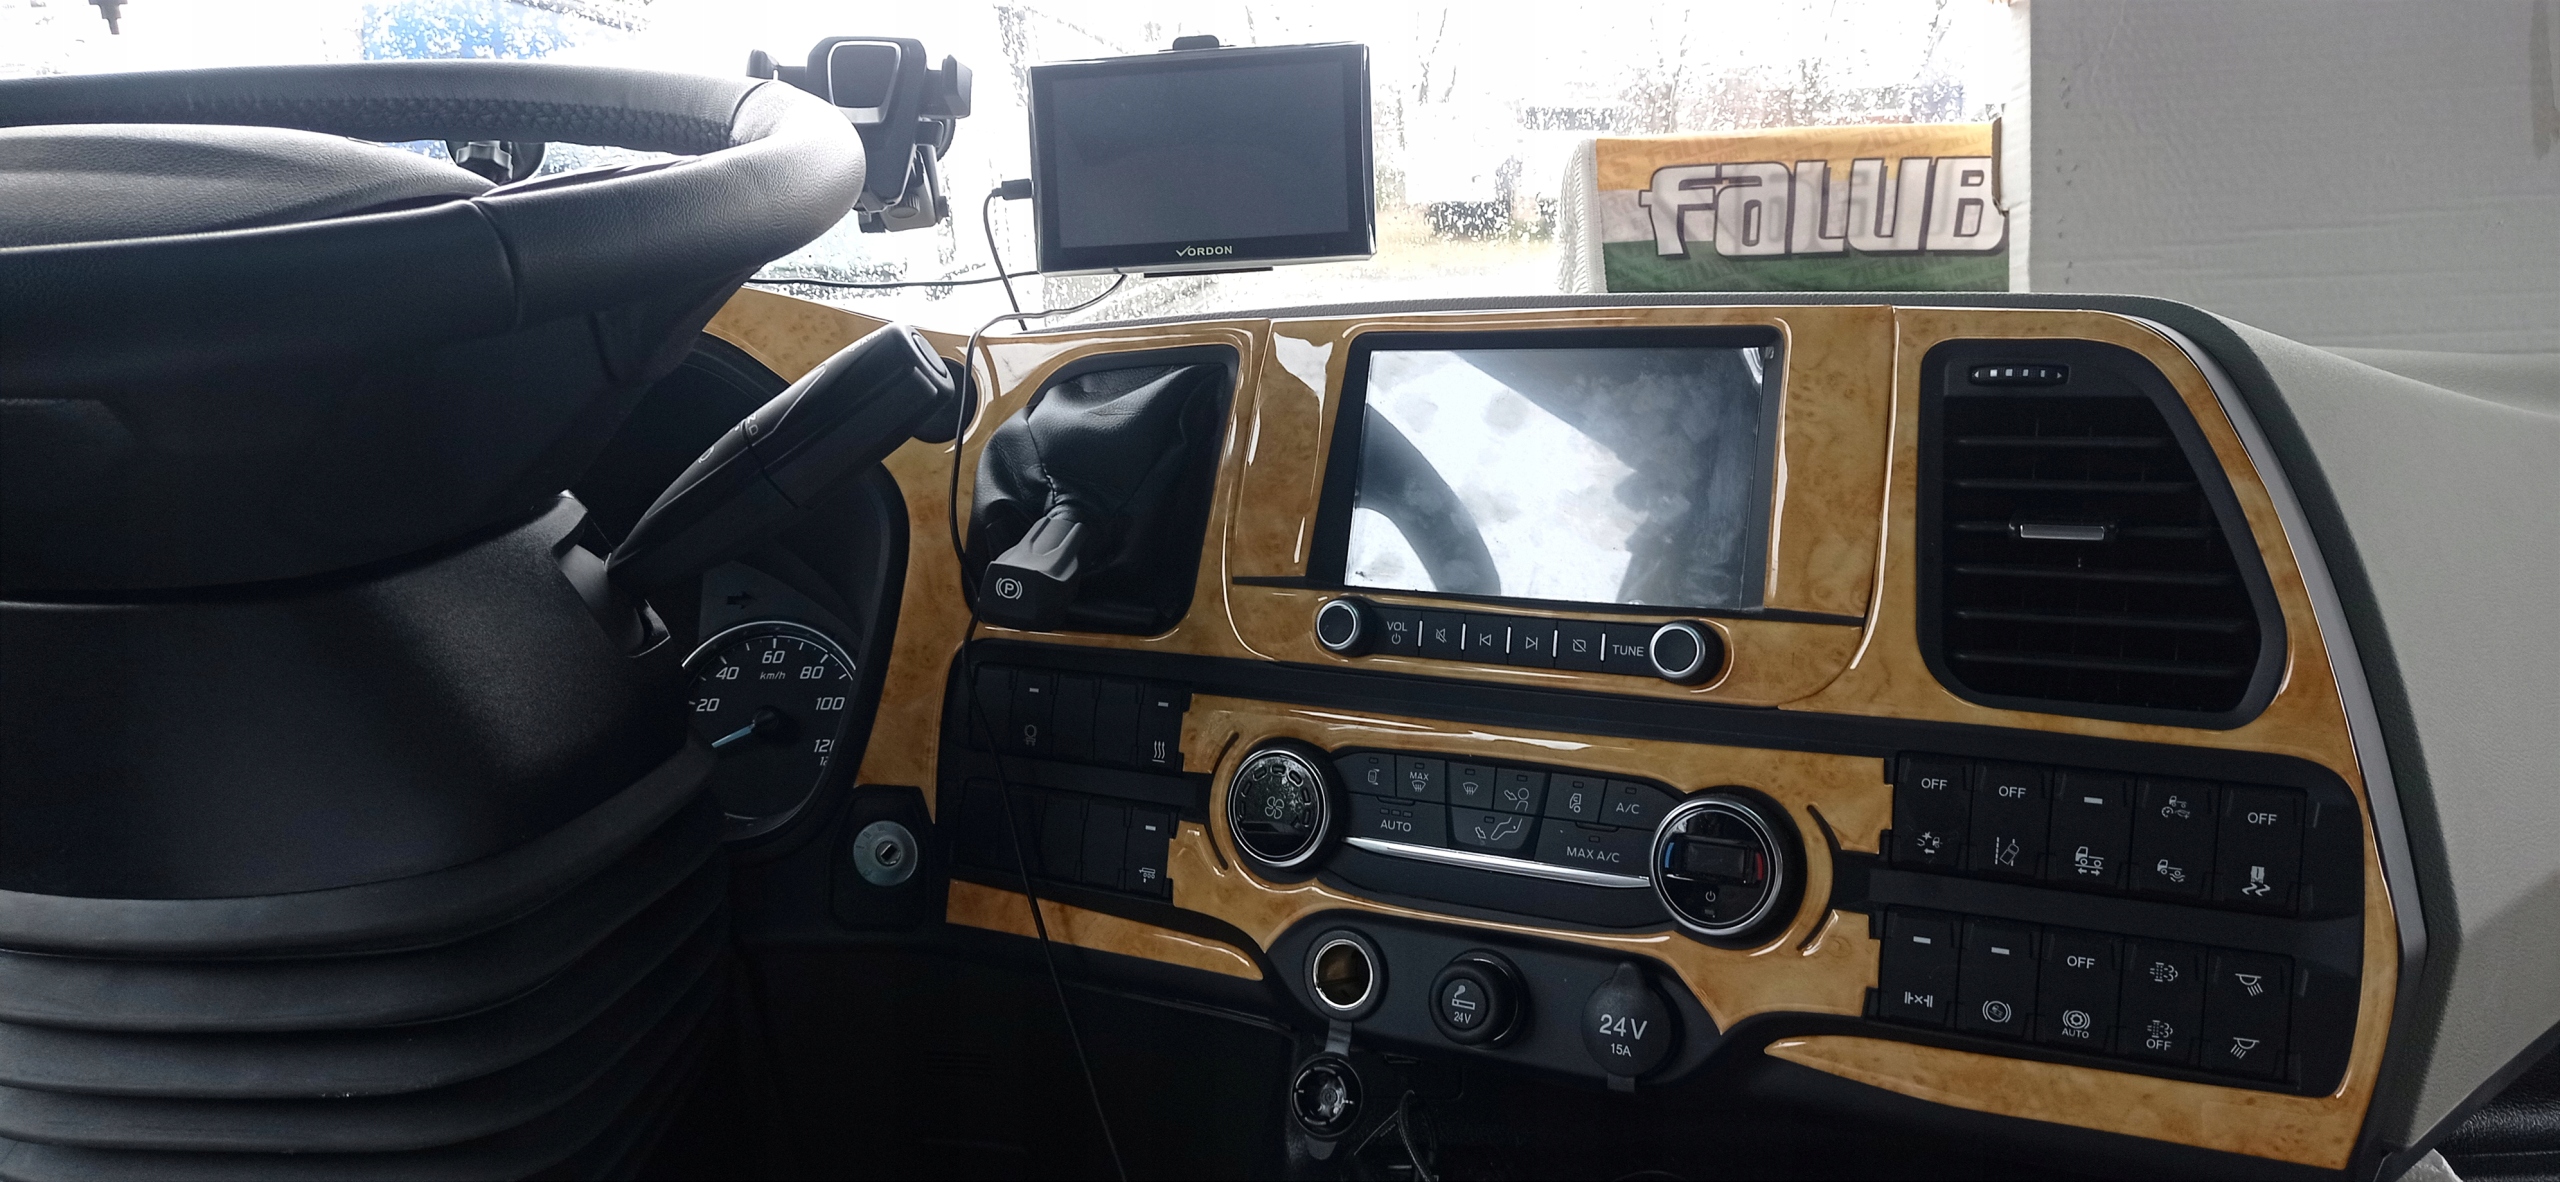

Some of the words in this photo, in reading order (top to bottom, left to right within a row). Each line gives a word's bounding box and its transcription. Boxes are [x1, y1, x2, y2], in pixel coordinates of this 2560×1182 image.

[1175, 245, 1233, 257] VORDON
[1386, 621, 1408, 632] VOL
[761, 650, 786, 664] 60
[1612, 644, 1644, 657] TUNE
[715, 666, 740, 680] 40
[759, 670, 786, 680] km/h
[799, 665, 825, 680] 80
[696, 698, 720, 712] 20
[815, 696, 846, 711] 100
[1409, 771, 1429, 781] MAX
[1921, 777, 1948, 791] OFF
[1998, 785, 2027, 799] OFF
[1615, 802, 1640, 815] A/C
[2247, 811, 2277, 826] OFF
[1380, 819, 1412, 833] AUTO
[1566, 846, 1594, 860] MAX
[1596, 850, 1620, 863] A/C
[2066, 955, 2095, 969] OFF
[1453, 1011, 1472, 1025] 24V
[2061, 1028, 2090, 1039] AUTO
[1610, 1042, 1632, 1058] 15A
[2145, 1038, 2172, 1051] OFF
